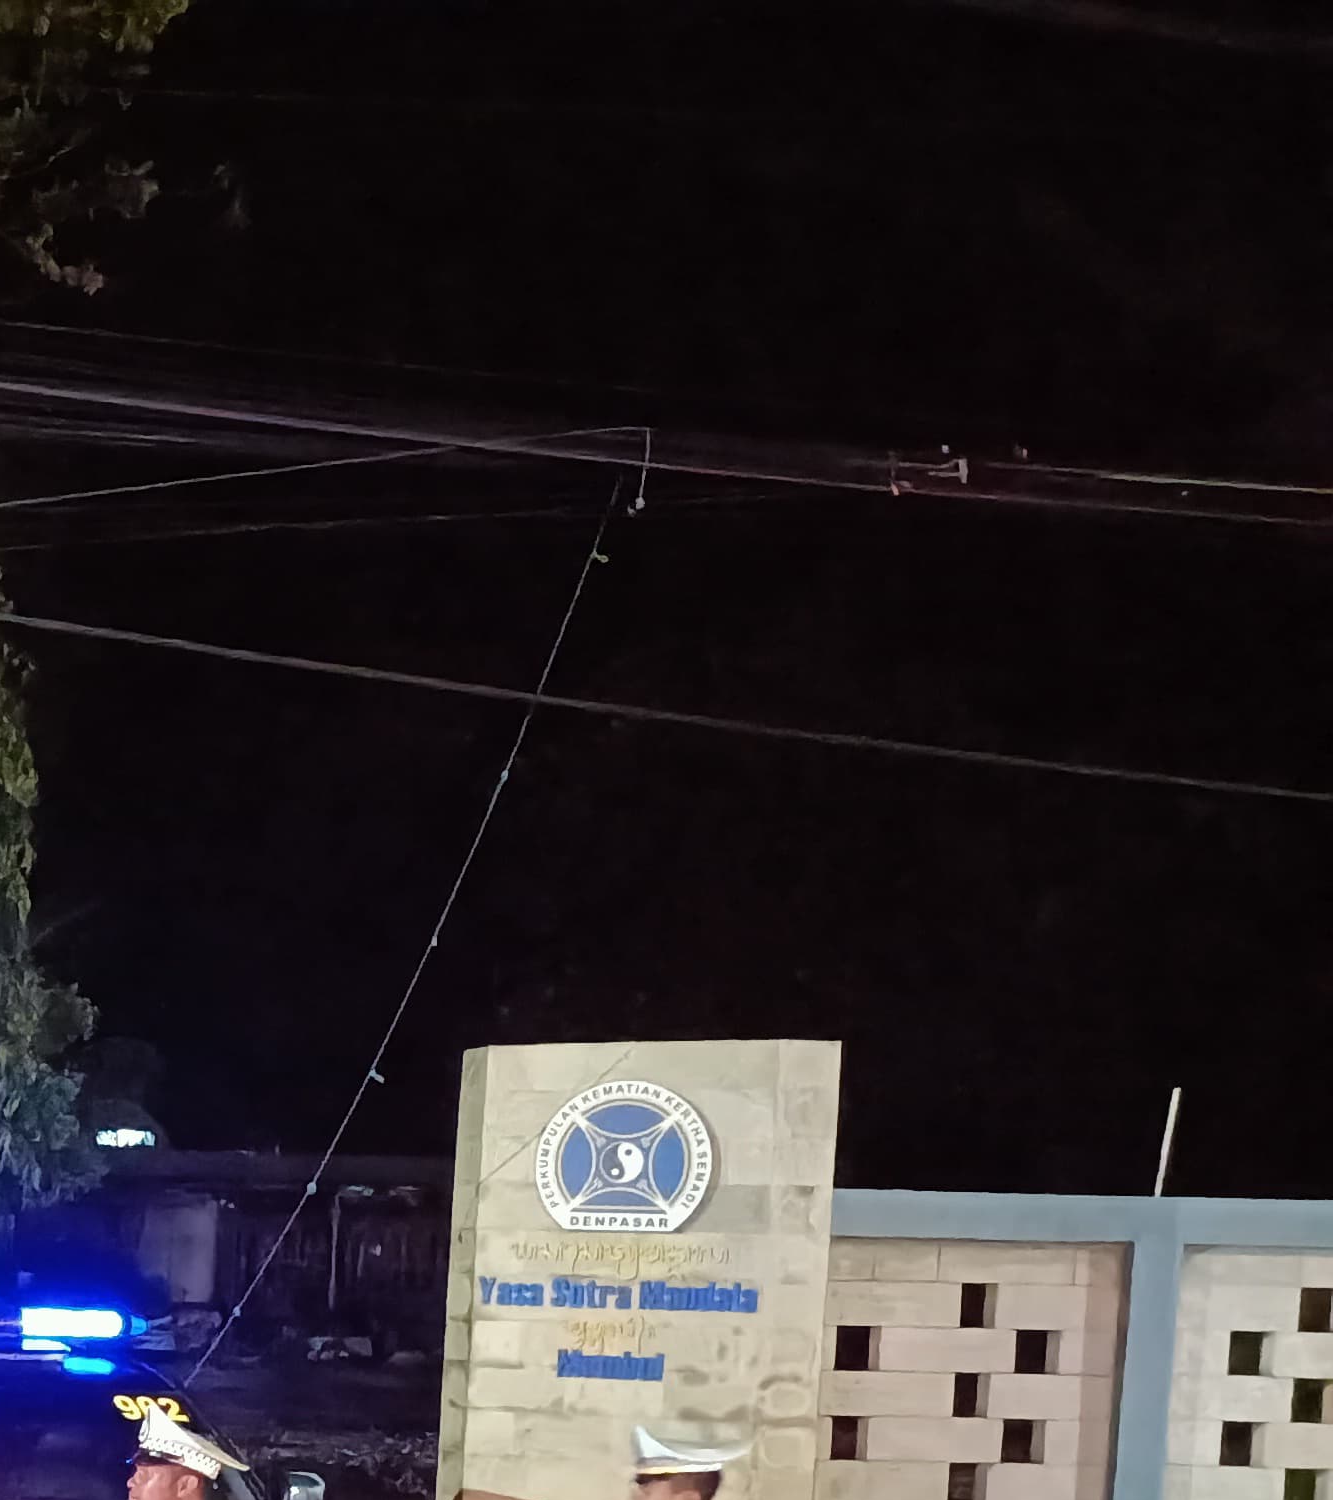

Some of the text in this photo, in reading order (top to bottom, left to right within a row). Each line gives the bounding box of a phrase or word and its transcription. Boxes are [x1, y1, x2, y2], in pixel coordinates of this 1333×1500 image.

[539, 1083, 709, 1209] PERKUMPULAN KEMATIAN KERTHA SEMADI
[569, 1215, 669, 1228] DENPASAR
